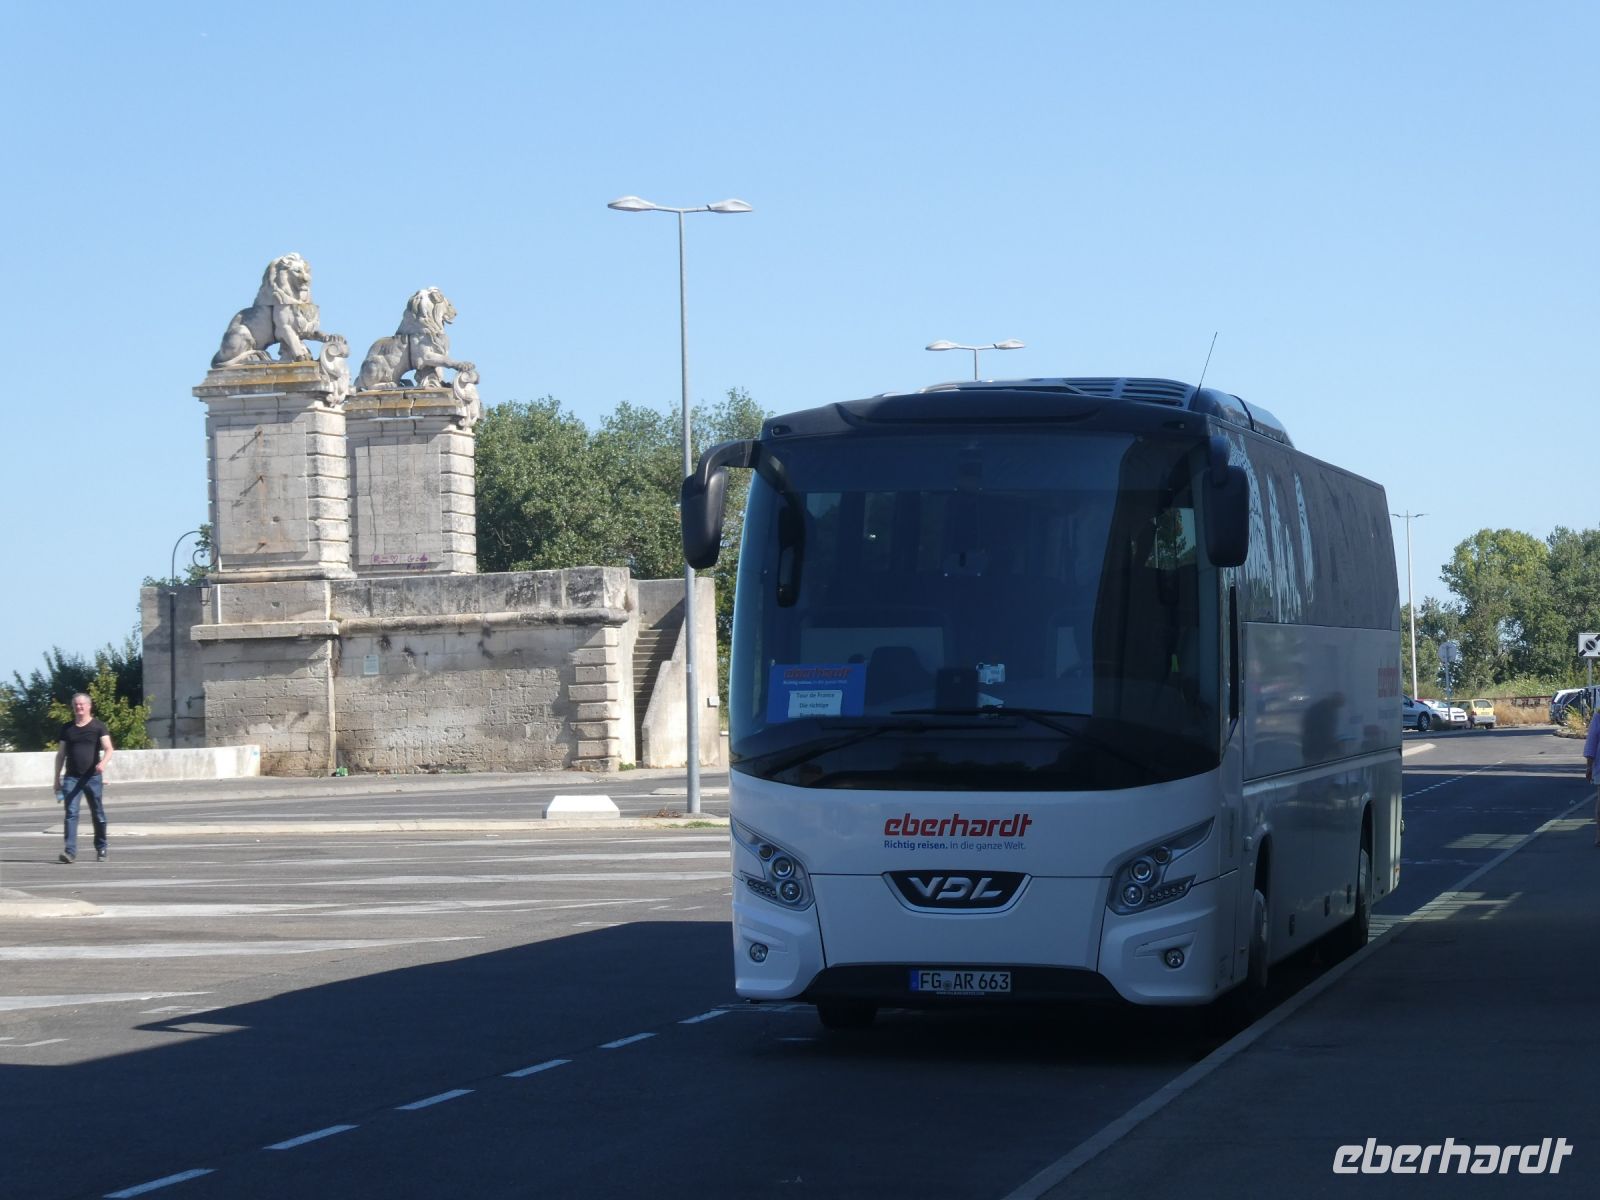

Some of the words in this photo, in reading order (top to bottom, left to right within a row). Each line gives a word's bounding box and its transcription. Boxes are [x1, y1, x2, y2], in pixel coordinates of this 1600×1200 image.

[884, 813, 1033, 837] eberhardt
[884, 840, 916, 851] Richtig
[917, 840, 948, 850] reisen.
[950, 840, 959, 849] In
[960, 840, 974, 850] die
[975, 841, 1002, 852] ganze
[1002, 841, 1027, 850] Welt.
[907, 876, 1003, 900] VDL
[920, 972, 942, 989] FG
[953, 973, 974, 989] AR
[978, 973, 1009, 990] 663
